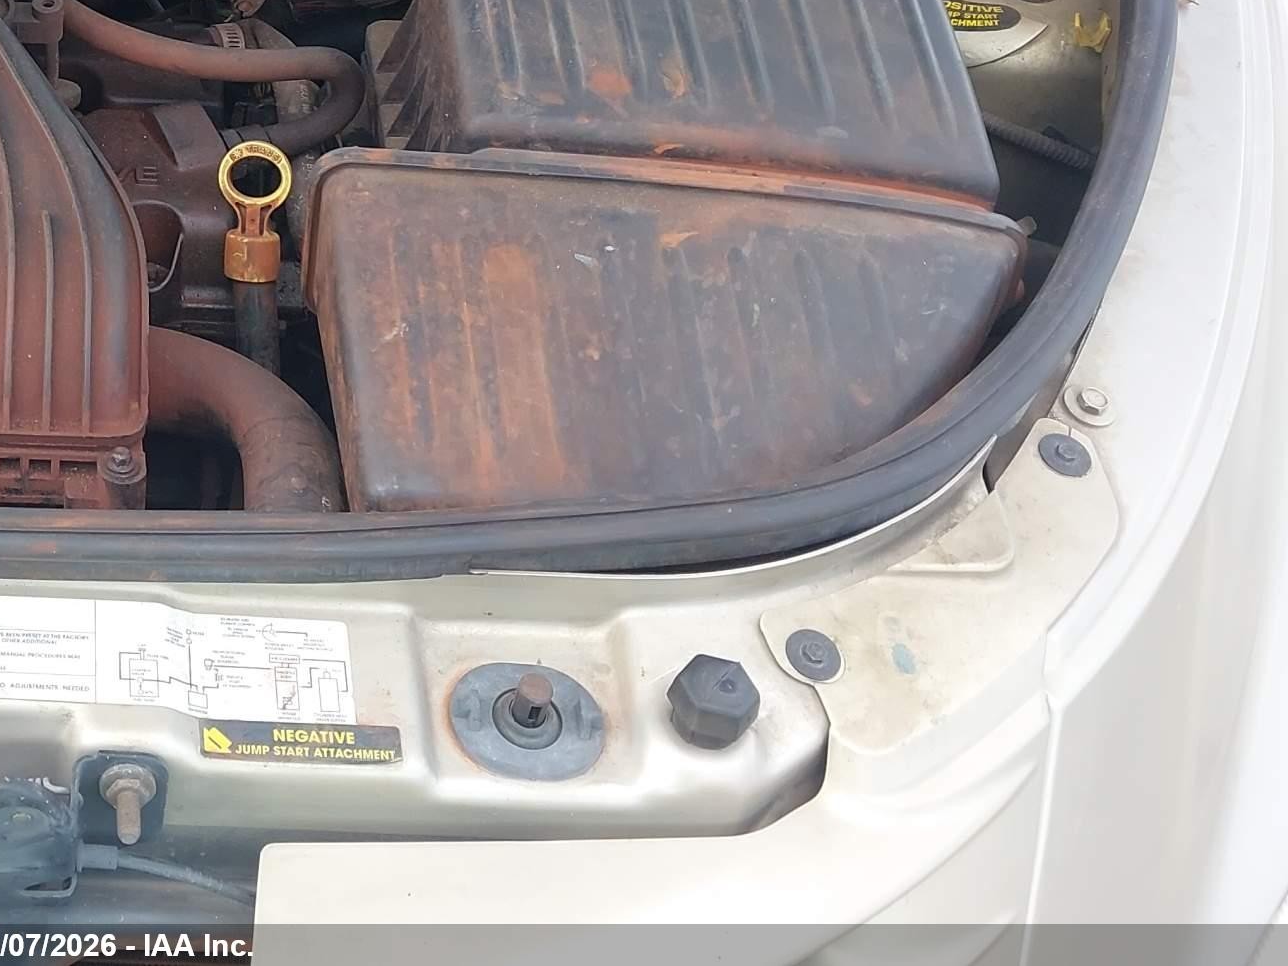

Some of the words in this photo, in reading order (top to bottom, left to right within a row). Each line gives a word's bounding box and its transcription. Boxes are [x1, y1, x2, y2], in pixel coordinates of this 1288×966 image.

[943, 0, 1004, 13] OSITIVE
[10, 682, 59, 690] ADJUSTMENTS
[62, 684, 90, 692] NEEDED
[273, 729, 355, 745] NEGATIVE
[235, 744, 270, 755] JUMP
[273, 746, 309, 757] START
[314, 747, 396, 760] ATTACHMENT
